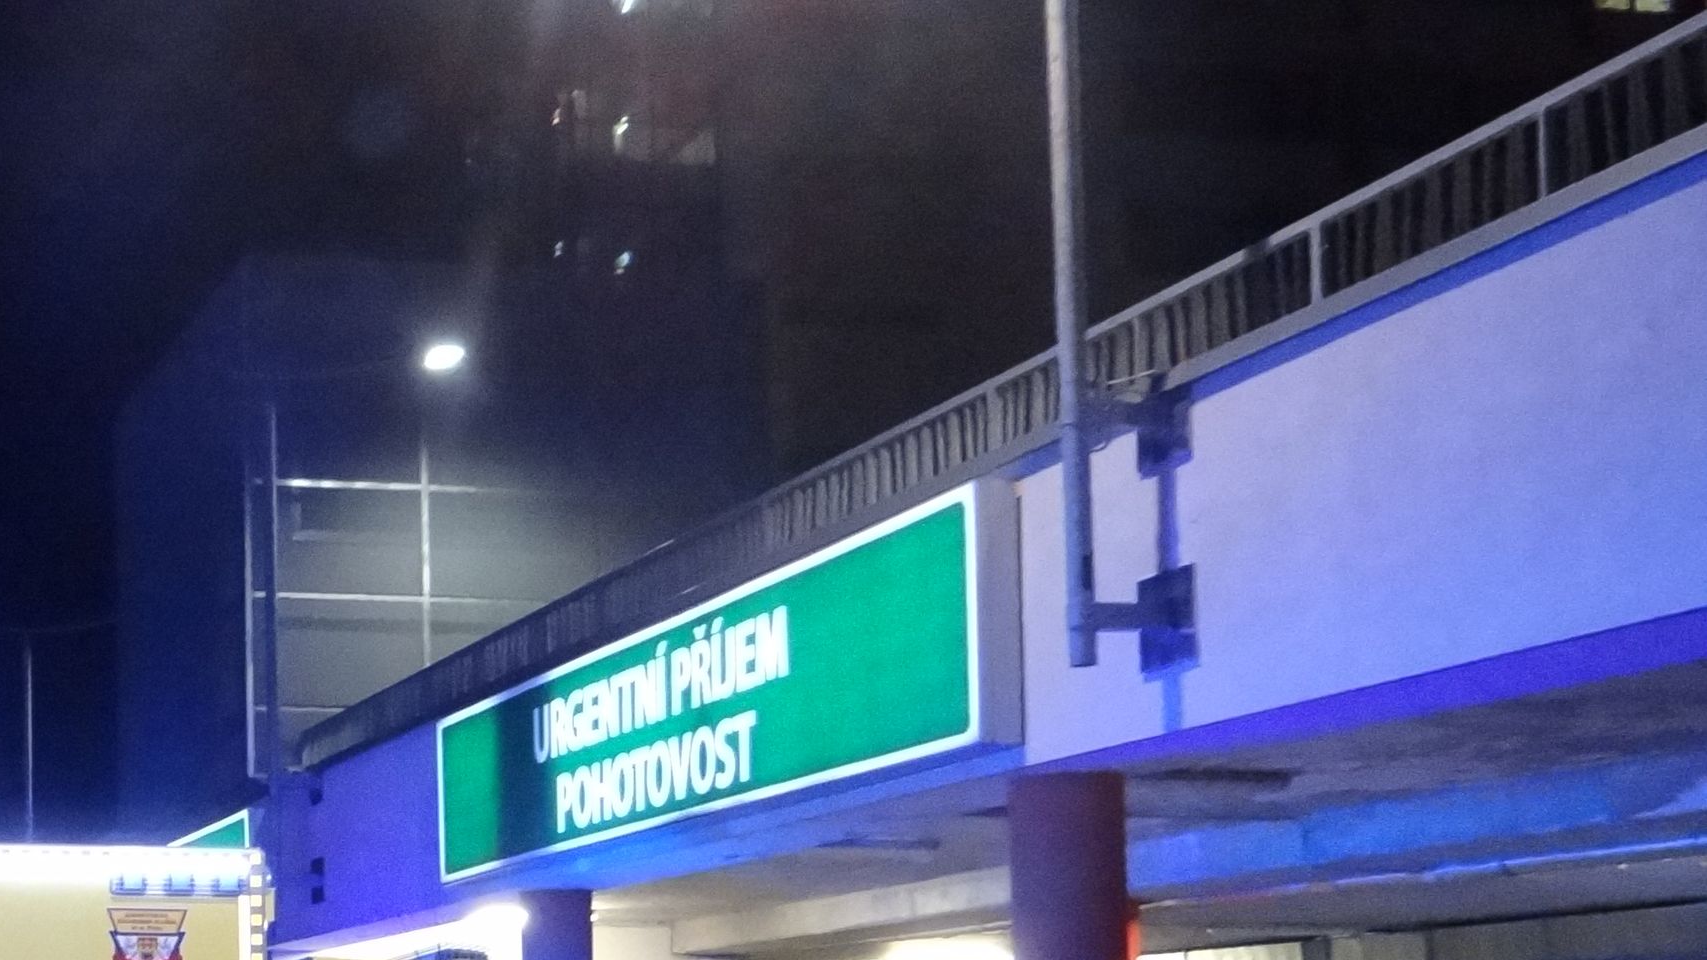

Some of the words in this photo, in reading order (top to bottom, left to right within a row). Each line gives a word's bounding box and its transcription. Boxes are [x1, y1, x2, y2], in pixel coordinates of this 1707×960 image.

[533, 640, 667, 763] URGENTNÍ
[670, 605, 790, 716] PŘÍJEM
[556, 709, 757, 833] POHOTOVOST
